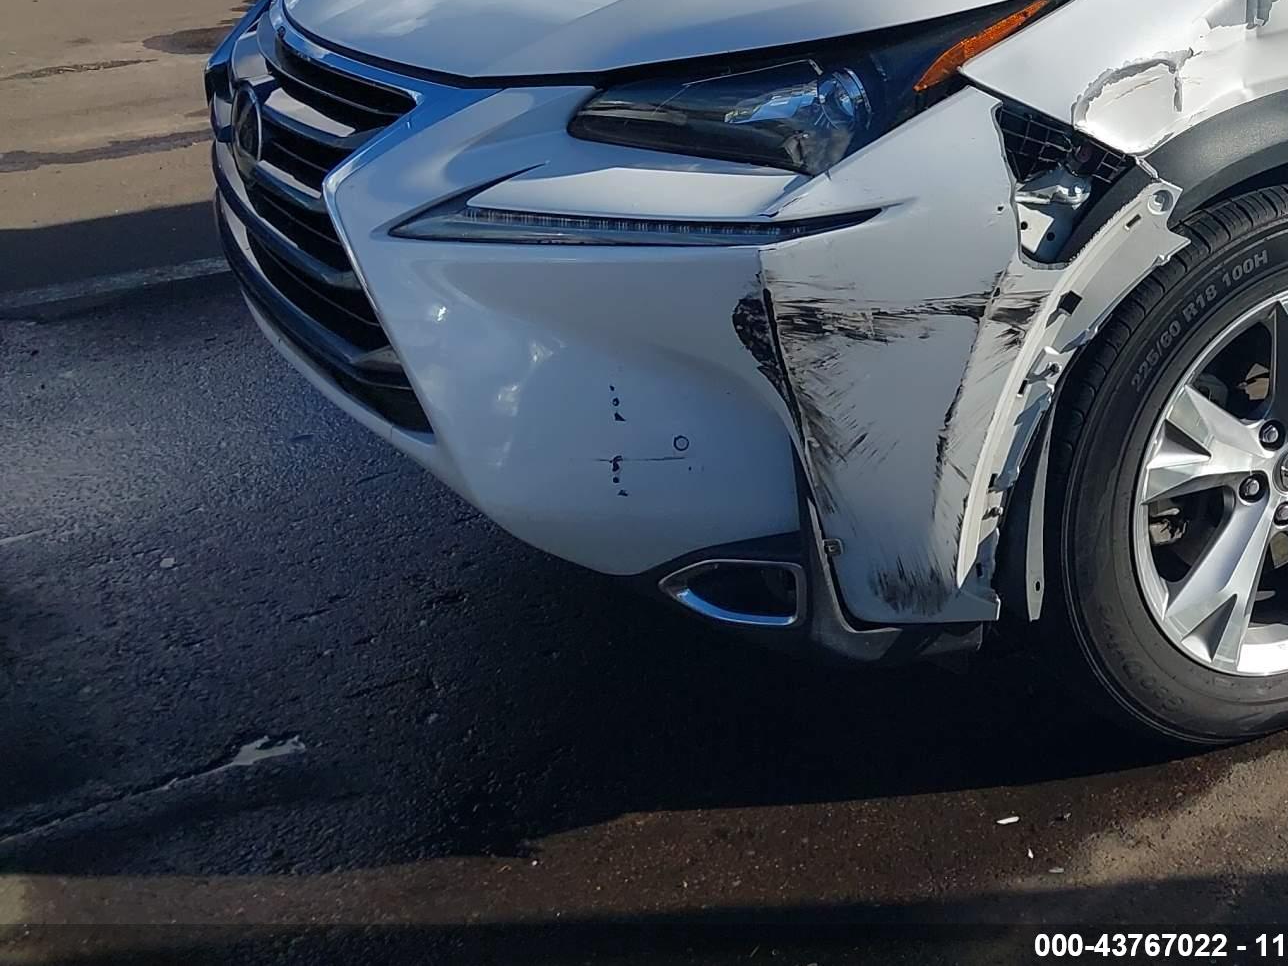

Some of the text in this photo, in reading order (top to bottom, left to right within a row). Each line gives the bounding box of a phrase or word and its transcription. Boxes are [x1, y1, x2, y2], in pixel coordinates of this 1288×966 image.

[1131, 249, 1269, 392] 225/60 R18 100H
